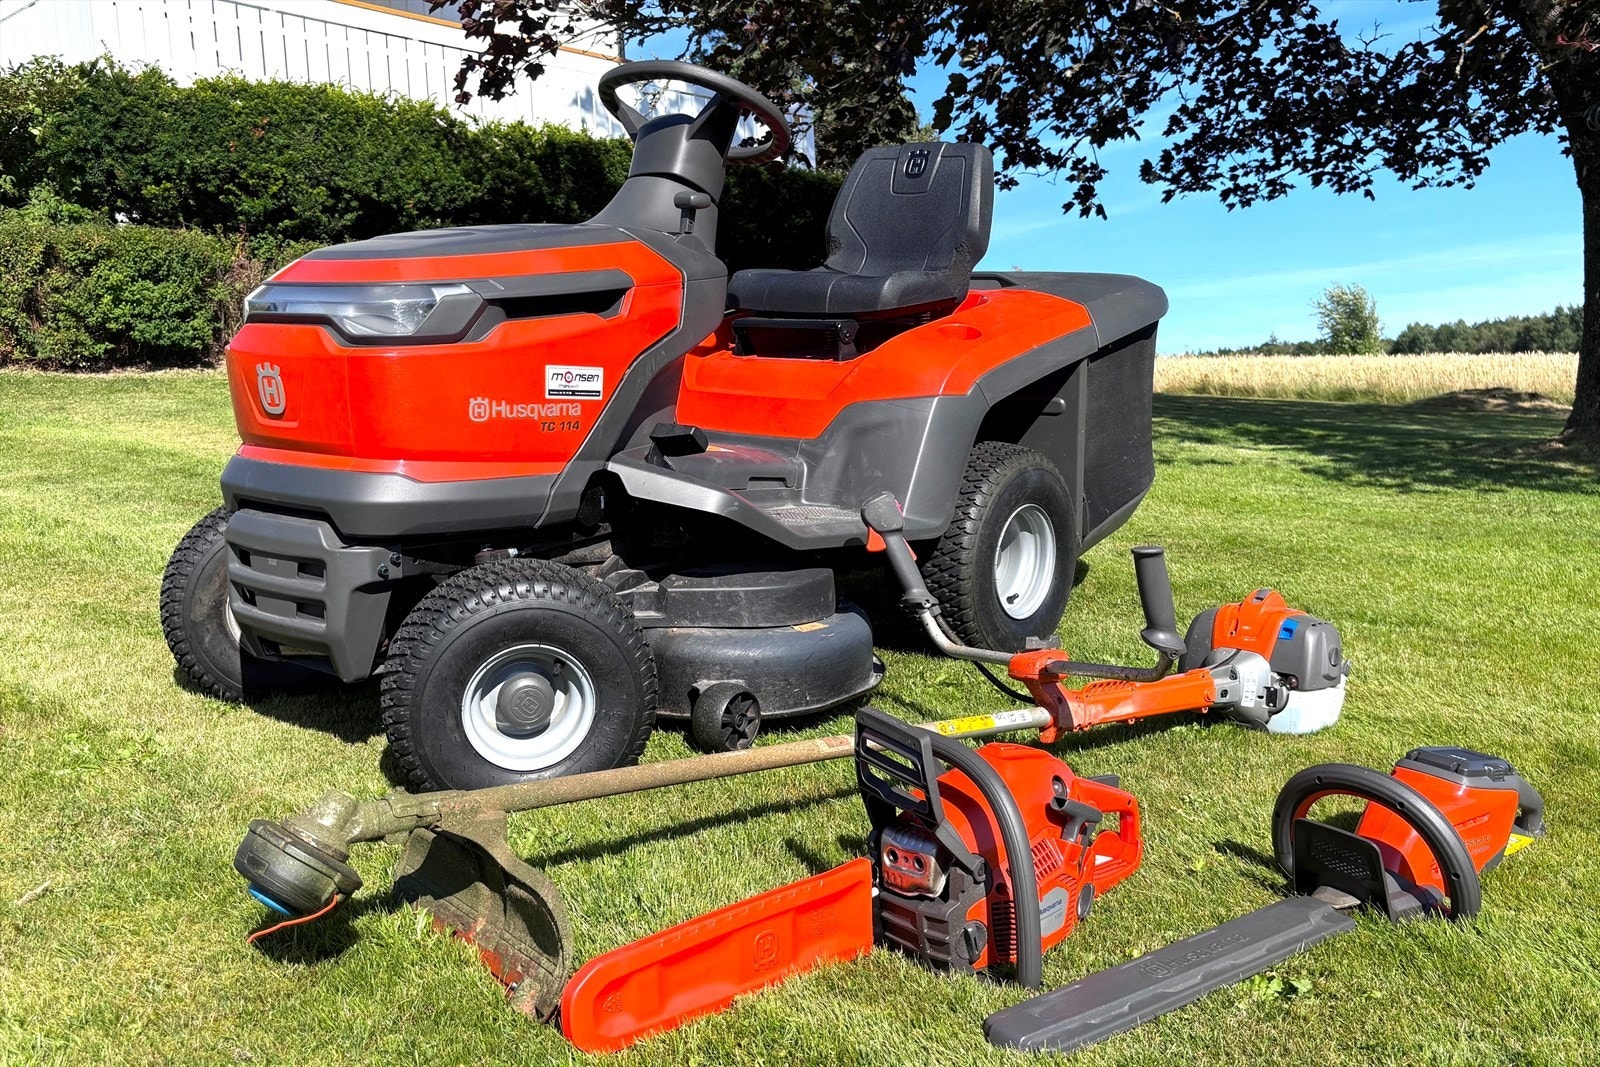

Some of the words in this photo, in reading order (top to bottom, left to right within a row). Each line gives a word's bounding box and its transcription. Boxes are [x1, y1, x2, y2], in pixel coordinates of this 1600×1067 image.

[551, 371, 600, 383] monsen
[491, 400, 581, 420] Husqvarna
[541, 421, 556, 432] TC
[559, 420, 580, 431] 114
